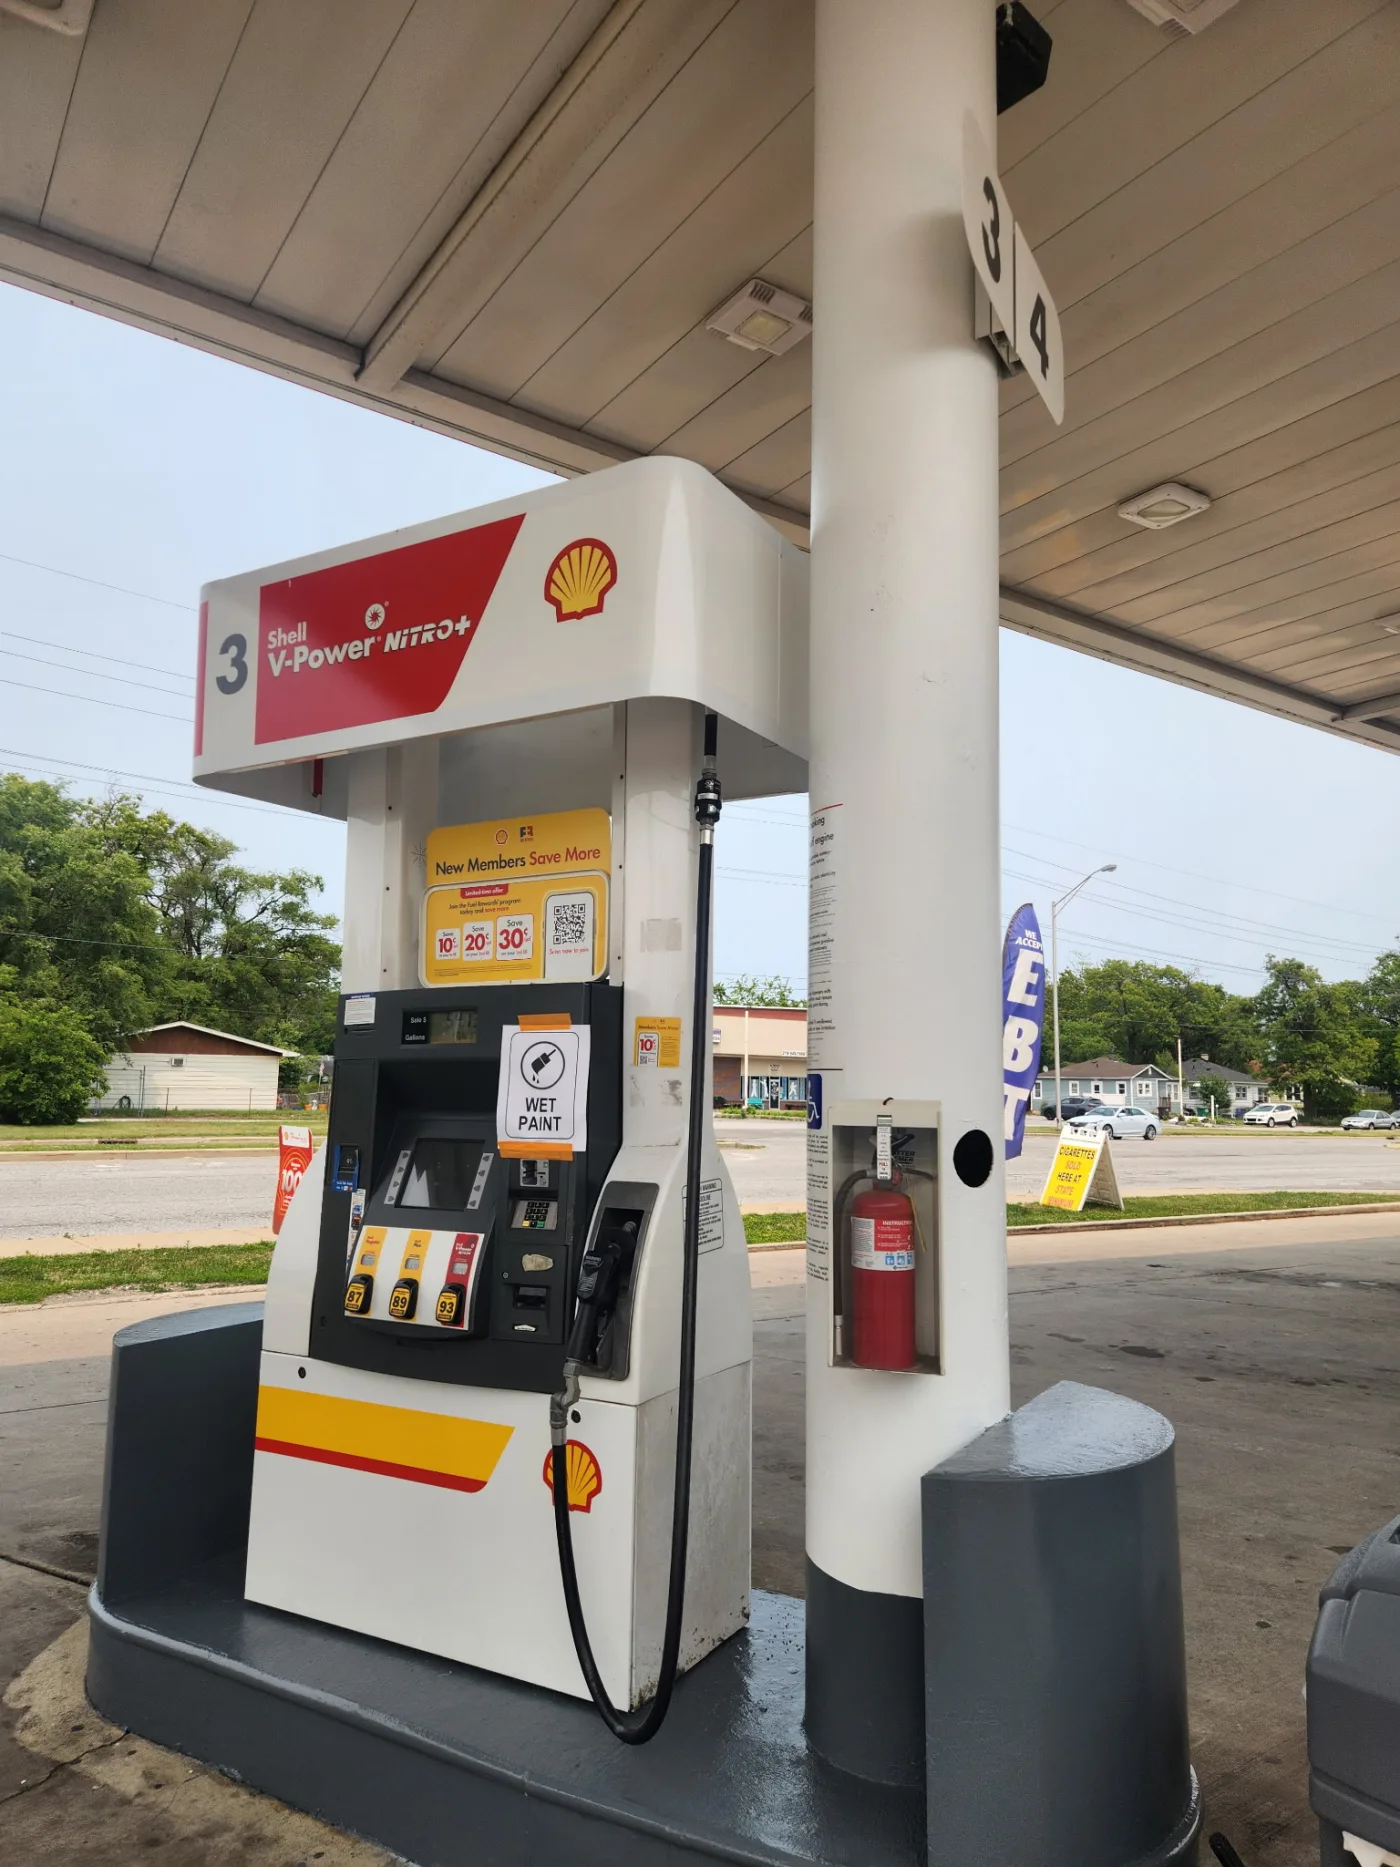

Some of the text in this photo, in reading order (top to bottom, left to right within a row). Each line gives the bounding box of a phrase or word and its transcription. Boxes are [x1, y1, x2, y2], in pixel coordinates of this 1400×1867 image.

[981, 176, 1001, 283] 3
[1030, 292, 1049, 381] 4
[267, 621, 307, 649] Shell
[215, 633, 248, 695] 3
[436, 846, 601, 875] New Members Save More
[1024, 929, 1037, 940] WE
[526, 1097, 556, 1112] WET
[518, 1116, 562, 1131] PAINT
[1060, 1146, 1096, 1160] CIGARETTES
[1057, 1172, 1082, 1183] HERE AT
[1055, 1185, 1074, 1195] STATE
[347, 1290, 362, 1303] 87
[392, 1296, 407, 1309] 89
[439, 1301, 454, 1314] 93
